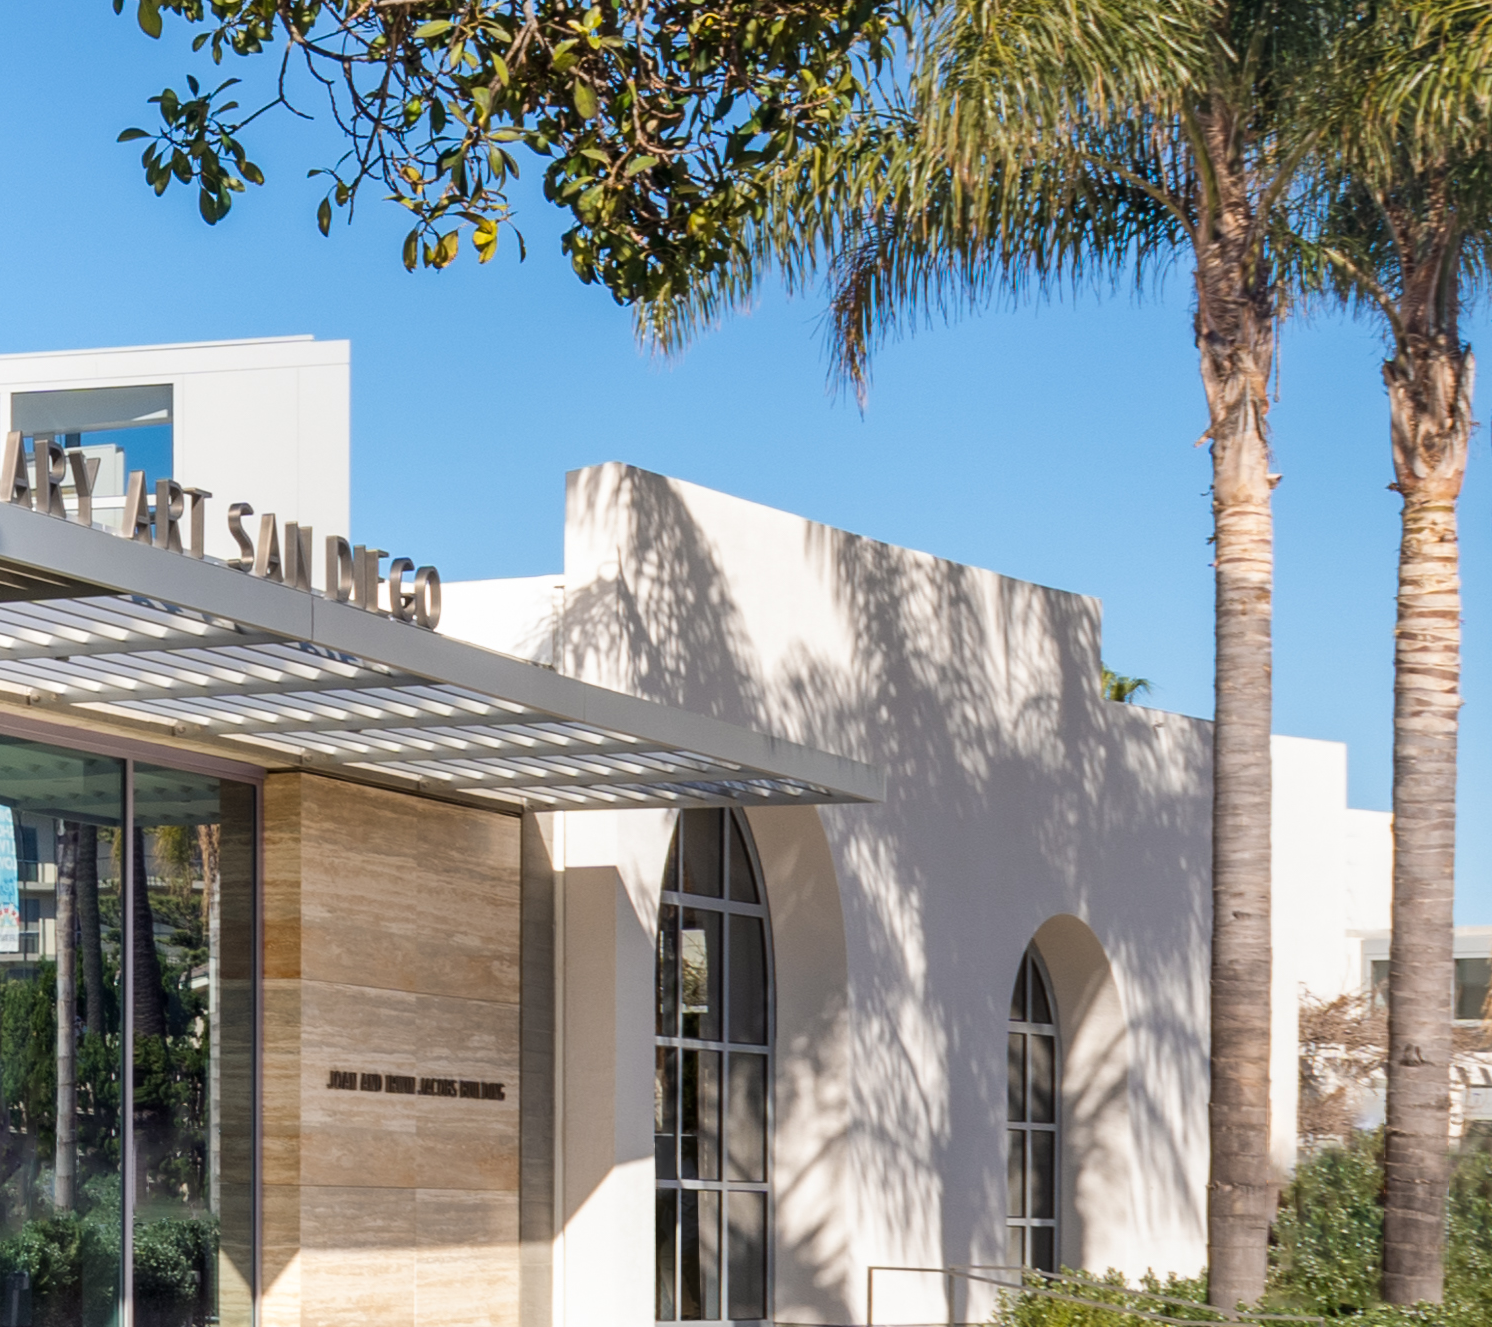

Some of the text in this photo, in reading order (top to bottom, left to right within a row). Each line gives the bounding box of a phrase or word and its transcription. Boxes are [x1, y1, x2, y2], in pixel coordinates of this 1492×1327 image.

[121, 469, 213, 561] ART
[227, 501, 313, 592] SAN
[324, 534, 442, 631] DIEGO
[326, 1070, 357, 1090] JOAN
[360, 1072, 382, 1092] AND
[417, 1077, 457, 1097] JACOBS
